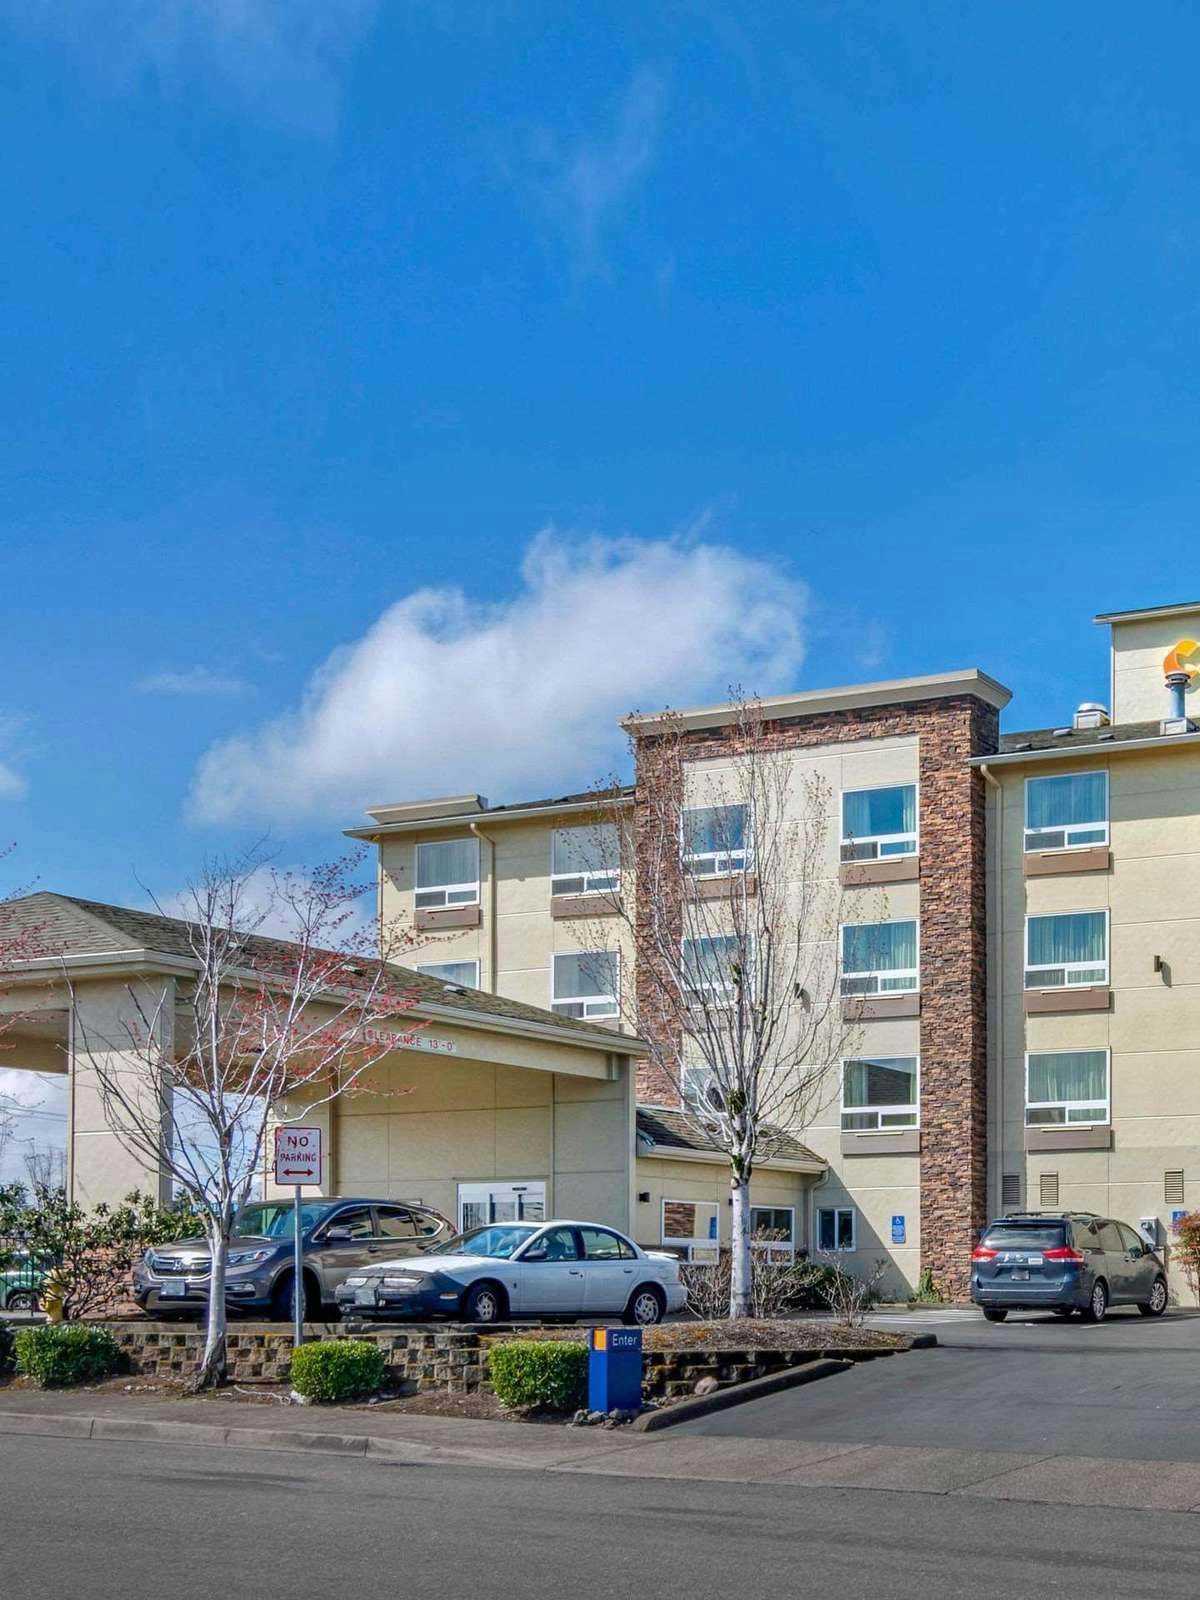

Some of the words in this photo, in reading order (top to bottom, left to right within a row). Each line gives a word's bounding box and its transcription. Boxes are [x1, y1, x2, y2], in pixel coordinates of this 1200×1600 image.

[287, 1136, 309, 1147] NO
[280, 1152, 317, 1162] PARKING
[612, 1334, 638, 1346] Enter
